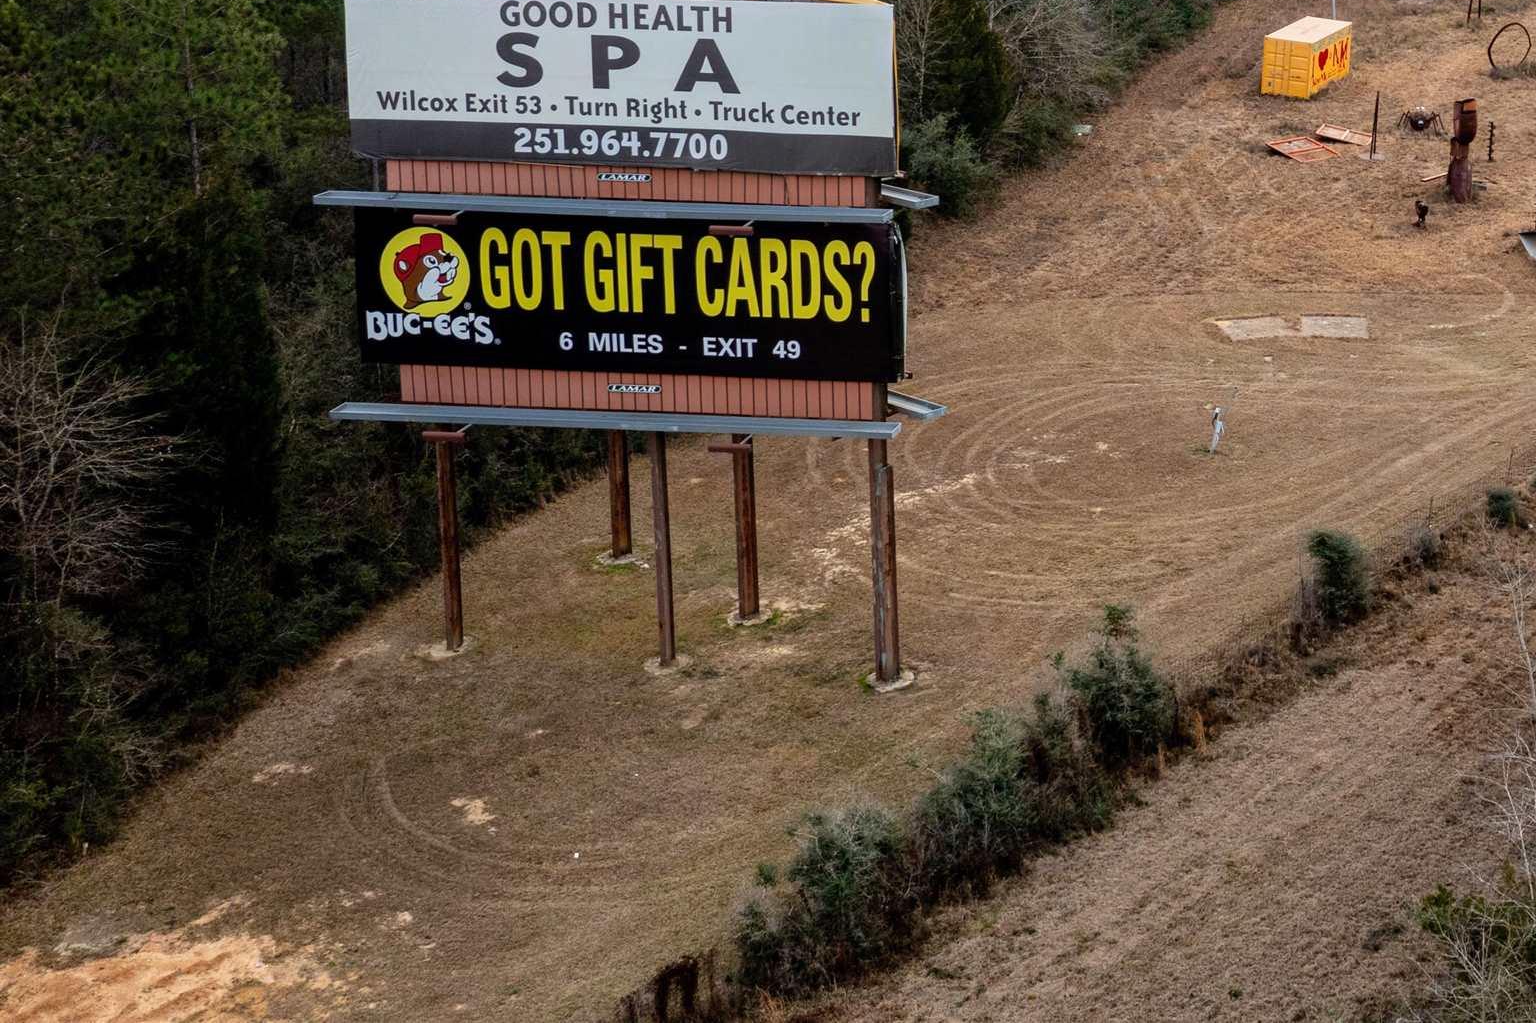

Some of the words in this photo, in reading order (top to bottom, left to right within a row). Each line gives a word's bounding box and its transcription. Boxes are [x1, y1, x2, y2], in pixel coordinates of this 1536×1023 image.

[499, 0, 599, 29] GOOD
[607, 2, 733, 34] HEALTH
[376, 89, 459, 113] Wilcox
[465, 92, 507, 115] Exit
[514, 95, 542, 115] 53
[564, 95, 618, 117] Turn
[626, 97, 688, 124] Right
[708, 100, 776, 125] Truck
[780, 104, 861, 127] Center
[513, 126, 730, 161] 251.964.7700
[601, 173, 647, 181] LAMAR
[479, 226, 571, 313] GOT
[583, 230, 683, 315] GIFT
[695, 235, 877, 323] CARDS?
[558, 331, 574, 352] 6
[588, 332, 664, 355] MILES
[702, 336, 758, 359] EXIT
[772, 339, 802, 360] 49
[611, 384, 656, 393] LAMAR
